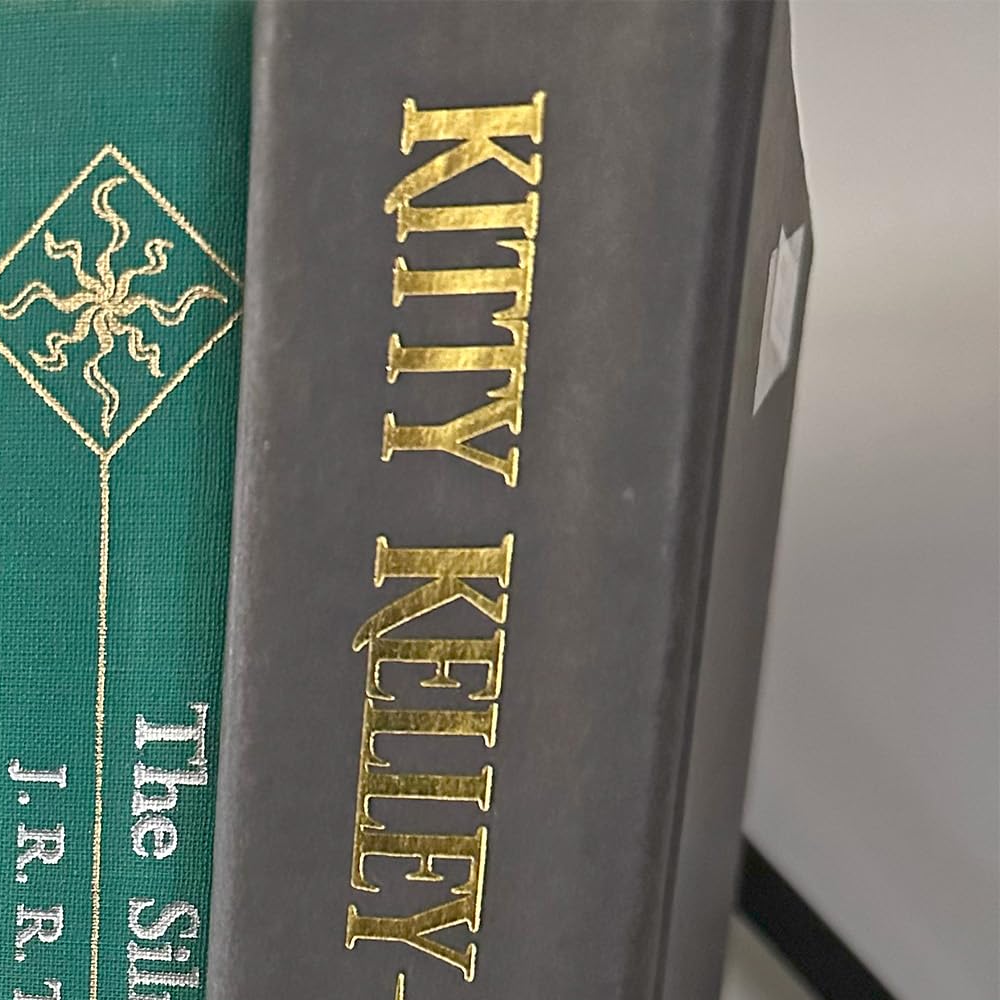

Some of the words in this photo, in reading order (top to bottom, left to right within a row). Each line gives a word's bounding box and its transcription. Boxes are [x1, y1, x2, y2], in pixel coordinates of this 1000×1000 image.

[381, 91, 546, 488] KITTY
[131, 702, 208, 859] The
[345, 533, 514, 982] KELLEY
